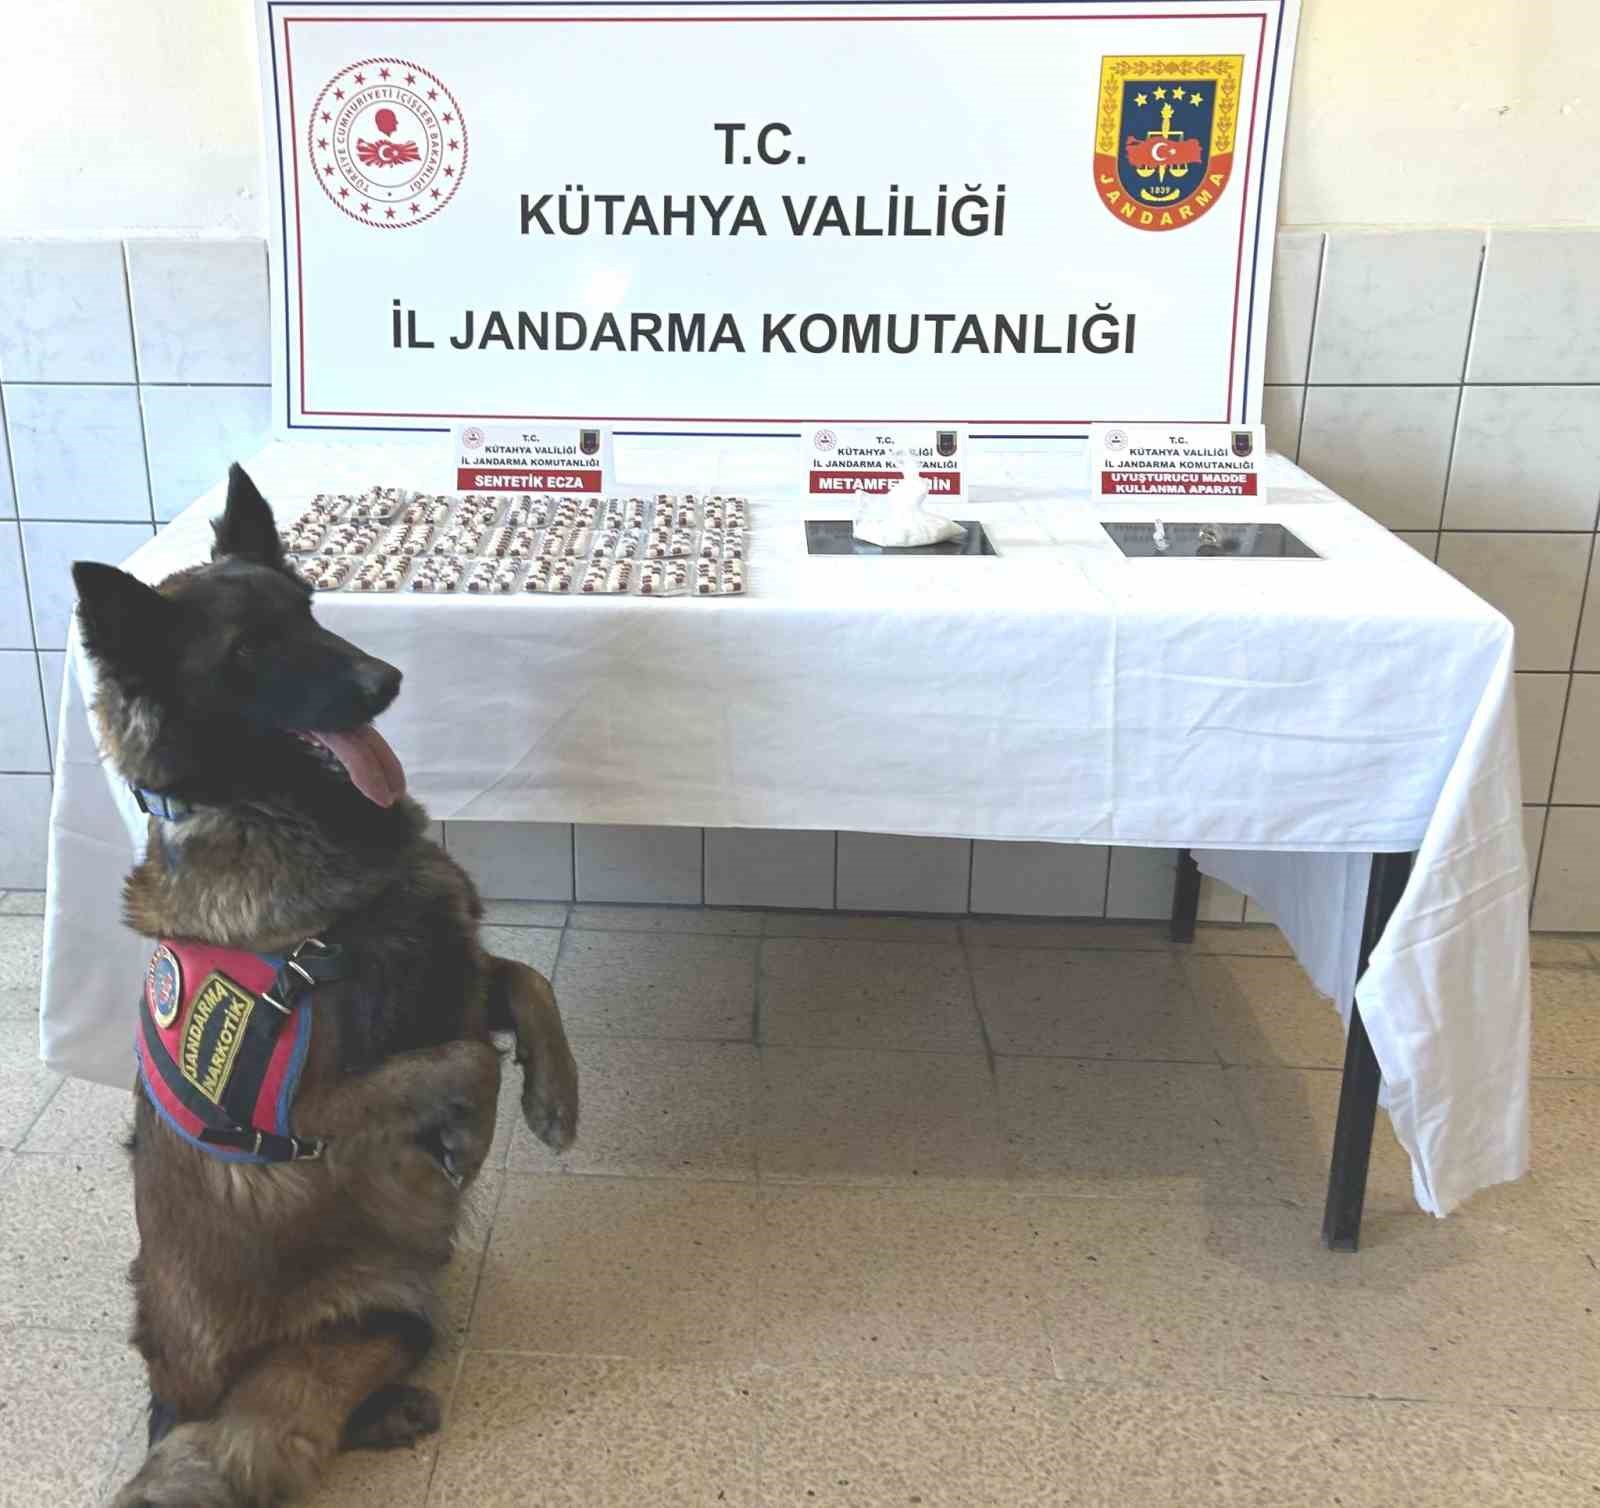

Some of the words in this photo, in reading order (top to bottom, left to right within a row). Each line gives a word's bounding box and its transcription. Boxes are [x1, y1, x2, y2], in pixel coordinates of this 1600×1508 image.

[336, 88, 393, 143] CUMHURİYETİ
[396, 88, 437, 130] İÇİŞLERİ
[714, 123, 806, 165] T.C.
[410, 132, 439, 192] BAKANLIĞI
[337, 149, 371, 192] TÜRKİYE
[1100, 173, 1225, 226] JANDARMA
[520, 184, 767, 236] KÜTAHYA
[783, 184, 1006, 236] VALİLİĞİ
[392, 299, 434, 349] İL
[450, 310, 746, 353] JANDARMA
[761, 302, 1137, 354] KOMUTANLIĞI
[522, 434, 540, 442] T.C.
[876, 436, 895, 444] T.C.
[1169, 436, 1189, 444] T.C.
[485, 445, 532, 454] KÜTAHYA
[535, 445, 577, 455] VALİLİĞİ
[837, 447, 886, 456] KÜTAHYA
[1129, 447, 1181, 456] KÜTAHYA
[1183, 448, 1228, 457] VALİLİĞİ
[461, 457, 470, 465] İL
[473, 458, 528, 466] JANDARMA
[530, 458, 600, 467] KOMUTANLIĞI
[813, 459, 823, 467] İL
[825, 460, 882, 468] JANDARMA
[1105, 459, 1114, 467] İL
[1118, 460, 1176, 468] JANDARMA
[1179, 460, 1254, 469] KOMUTANLIĞI
[475, 474, 544, 488] SENTETİK
[547, 476, 584, 488] ECZA
[1111, 472, 1199, 484] UYUŞTURUCU
[1202, 473, 1248, 483] MADDE
[1116, 484, 1185, 494] KULLANMA
[1189, 485, 1243, 494] APARATI
[185, 981, 229, 1079] JANDARMA
[202, 997, 245, 1094] NARKOTİK
